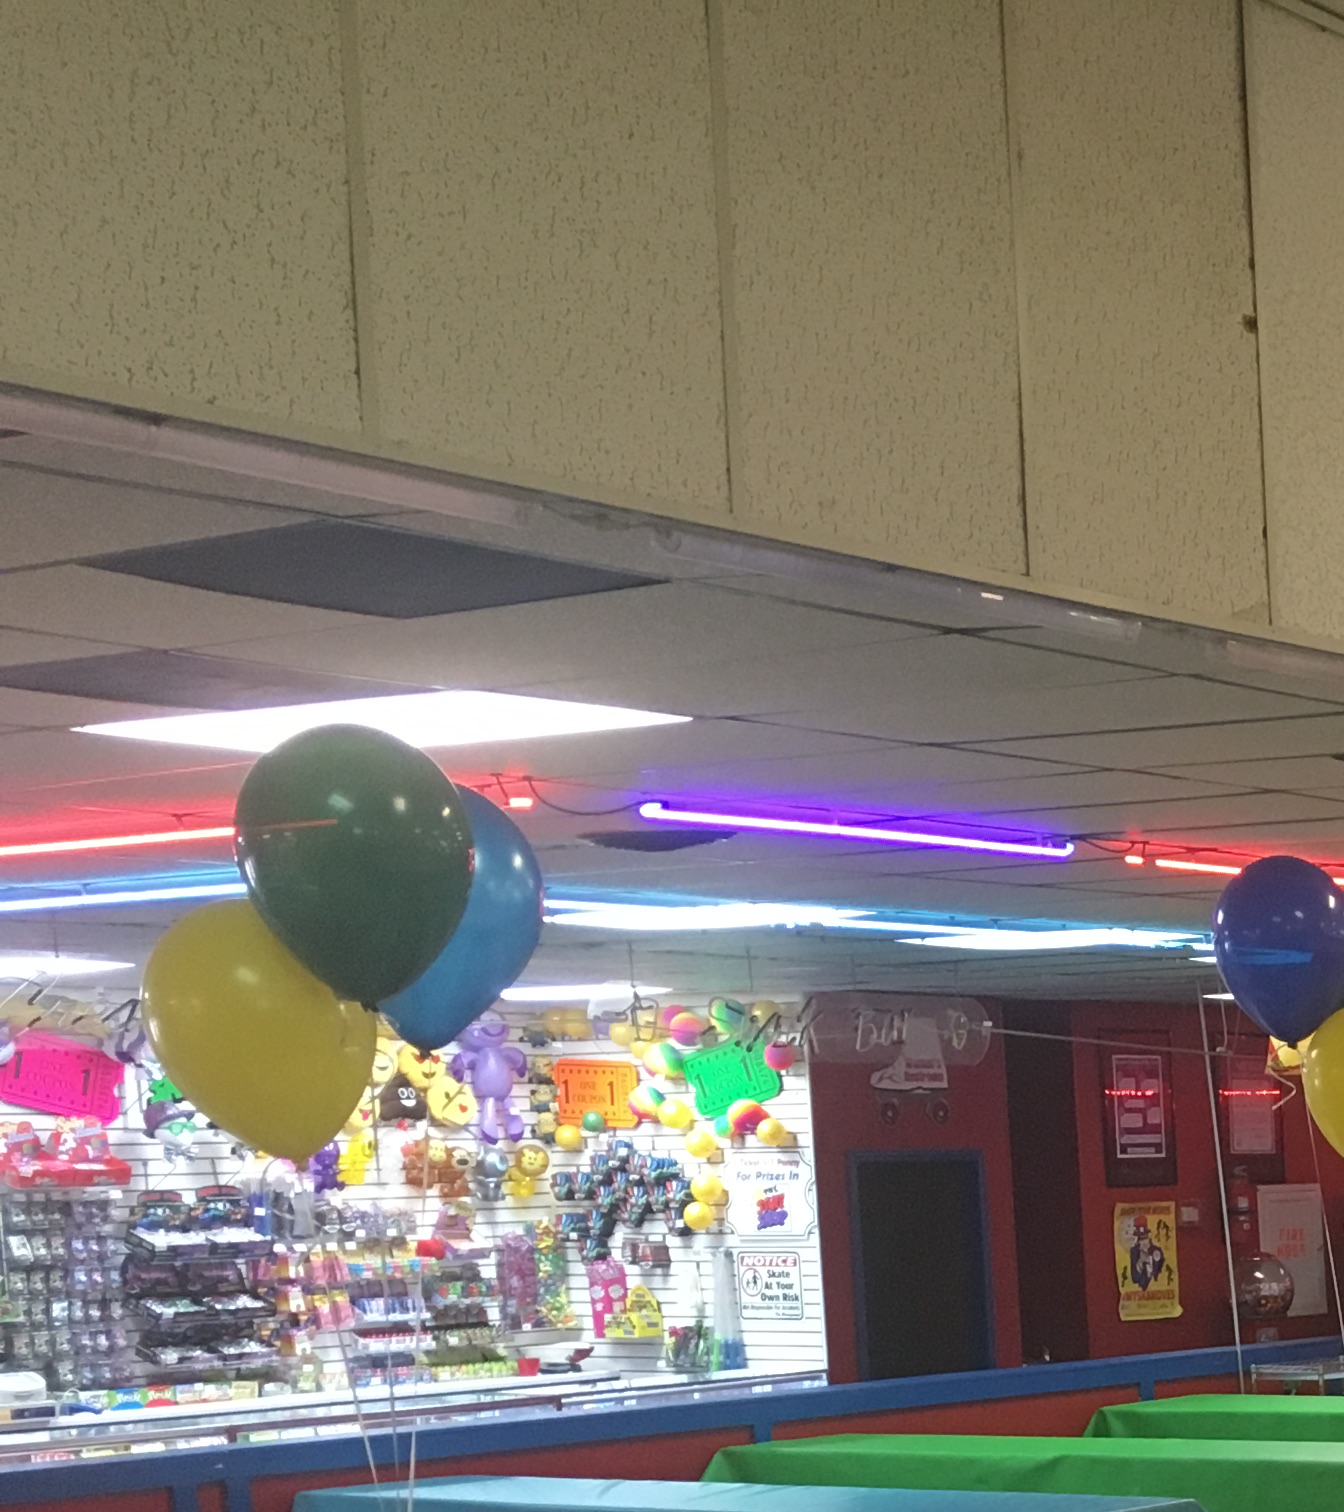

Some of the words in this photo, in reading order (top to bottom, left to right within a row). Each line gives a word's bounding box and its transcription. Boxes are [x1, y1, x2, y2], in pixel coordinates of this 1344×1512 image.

[736, 1171, 751, 1181] For
[755, 1171, 785, 1181] Prizes
[788, 1169, 800, 1181] In
[1278, 1228, 1306, 1242] FIRE
[742, 1256, 796, 1267] NOTICE
[766, 1269, 790, 1279] Skate
[764, 1281, 774, 1290] At
[775, 1280, 794, 1290] Your
[760, 1292, 781, 1302] Own
[782, 1292, 800, 1302] Risk
